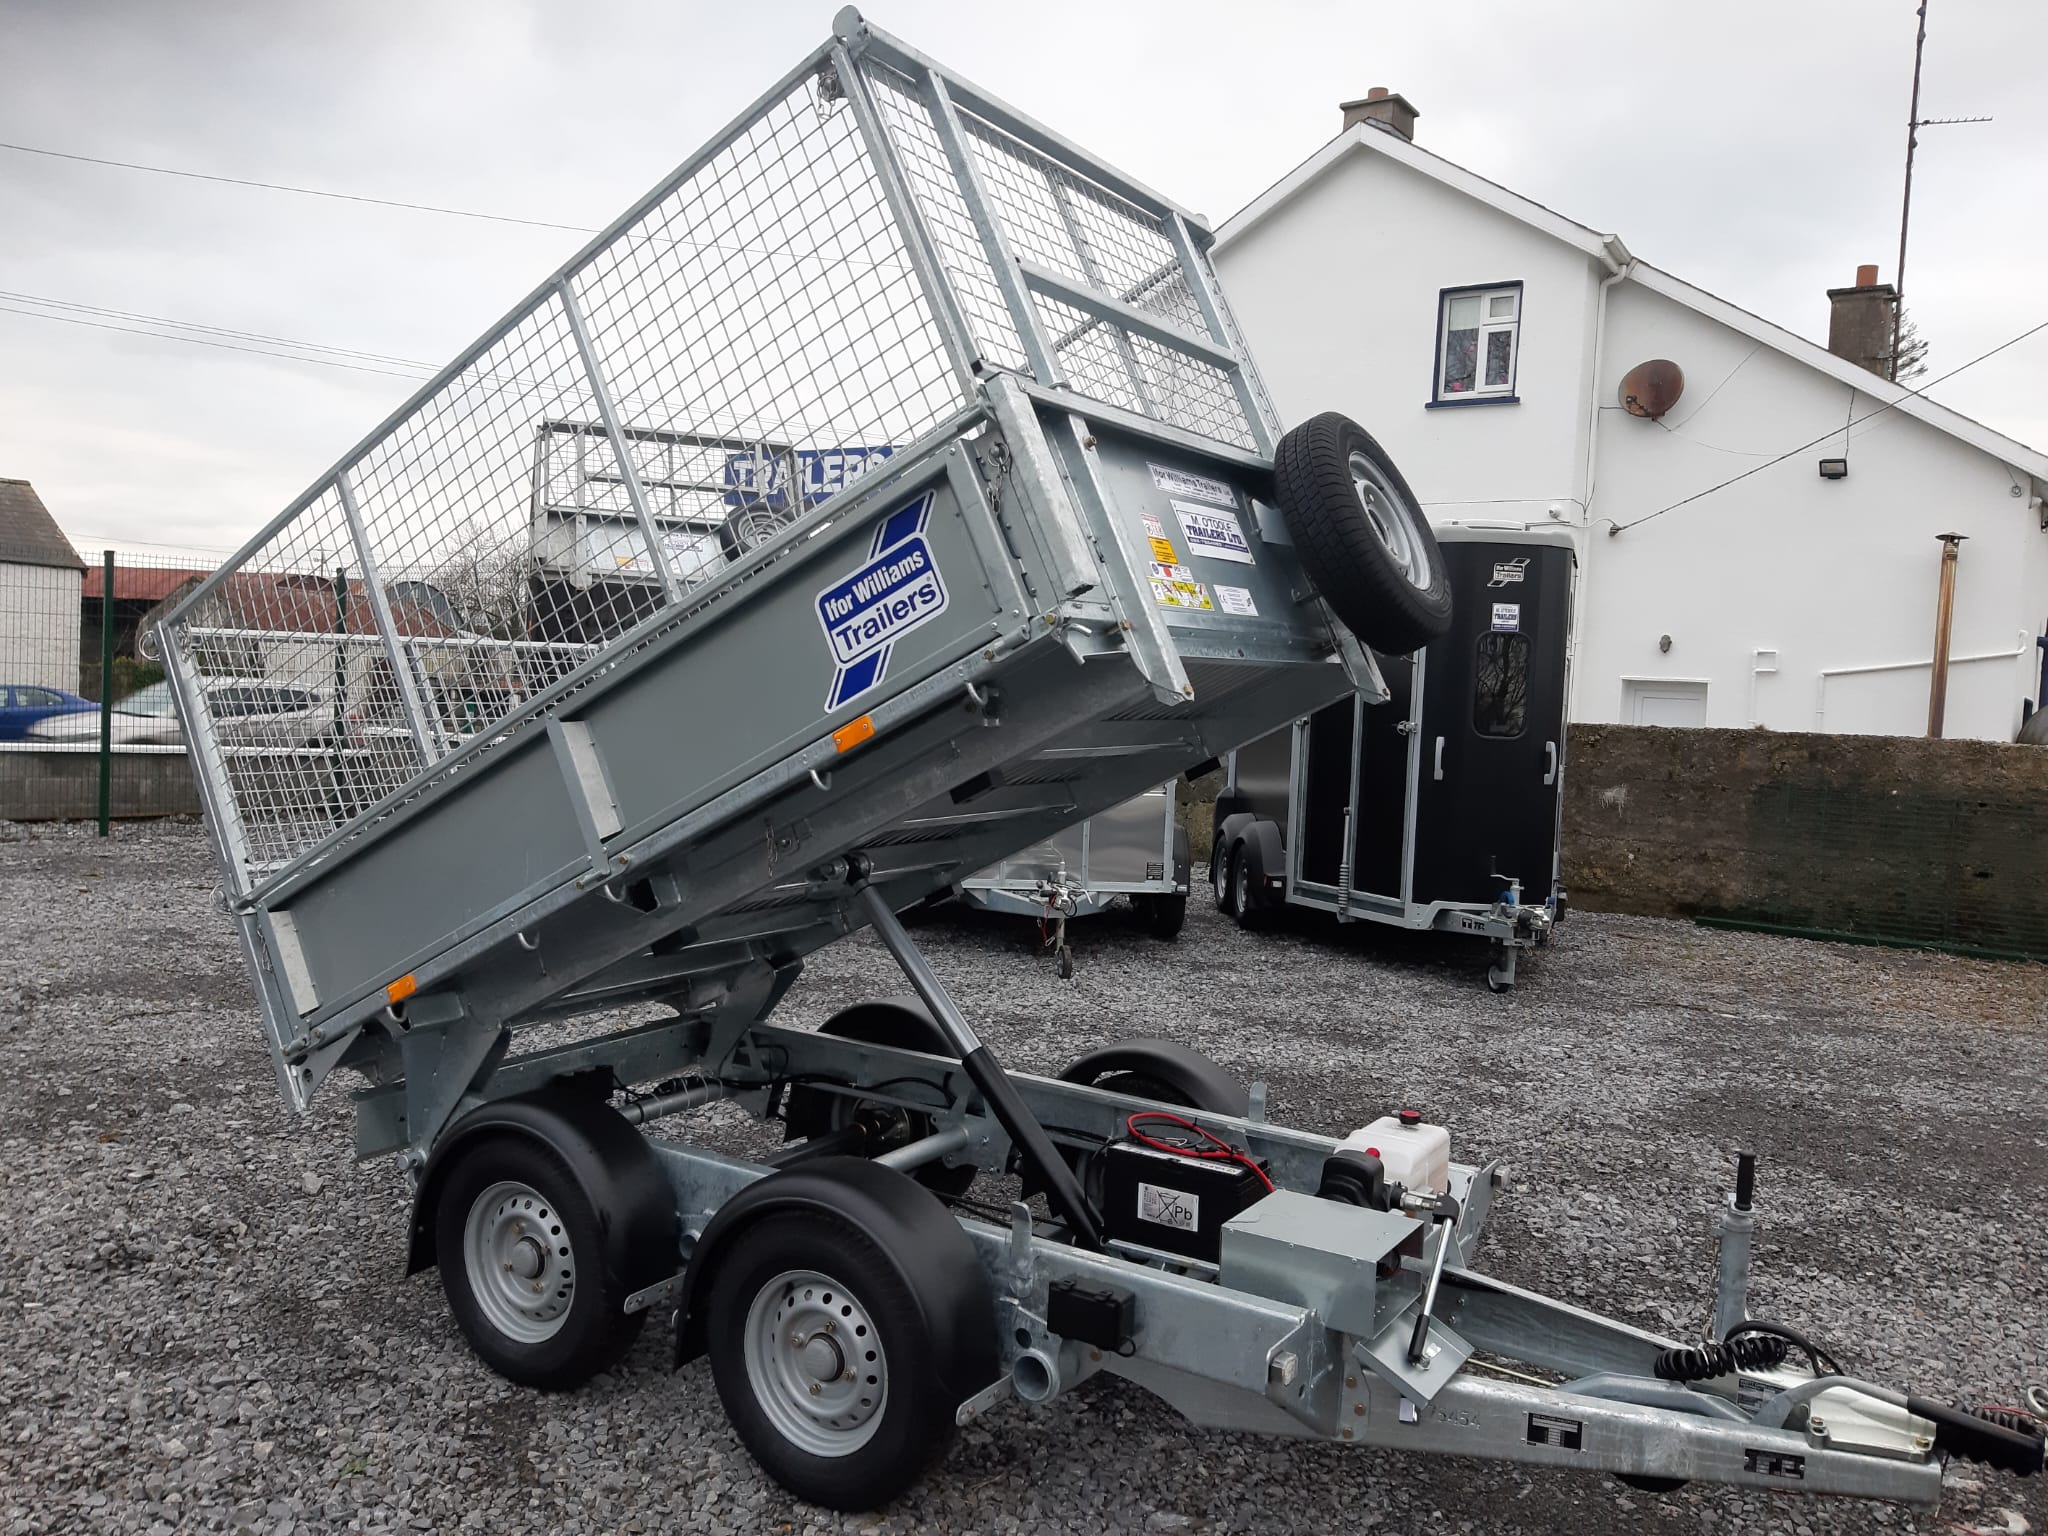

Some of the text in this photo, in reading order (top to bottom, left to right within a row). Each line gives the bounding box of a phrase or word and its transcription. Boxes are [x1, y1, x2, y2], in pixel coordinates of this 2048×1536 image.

[1186, 525, 1227, 543] TRAILERS
[824, 551, 925, 623] Ifor Williams
[836, 583, 937, 651] Trailers
[1174, 1205, 1193, 1221] Pb
